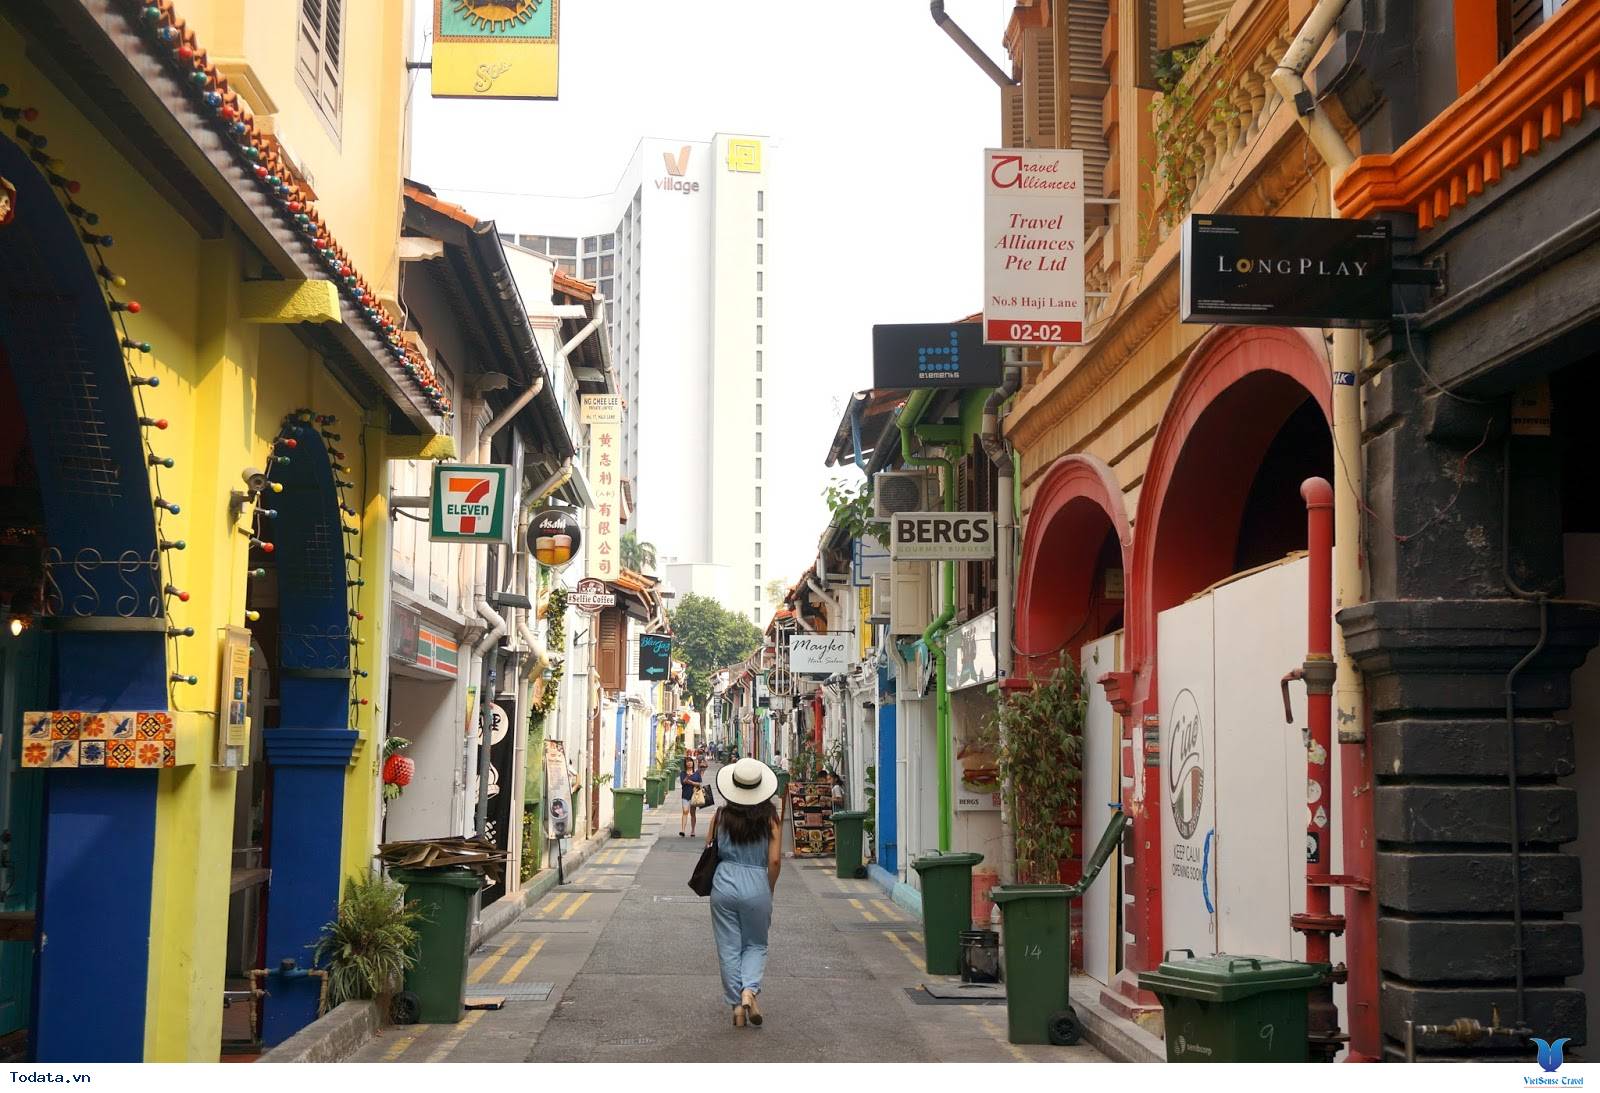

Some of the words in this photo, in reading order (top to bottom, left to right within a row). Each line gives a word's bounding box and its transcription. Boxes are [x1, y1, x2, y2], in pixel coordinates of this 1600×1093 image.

[654, 177, 700, 195] village
[1009, 213, 1064, 230] Travel
[994, 234, 1075, 251] Alliances
[1005, 255, 1032, 271] Pte
[1038, 256, 1067, 271] Ltd
[992, 295, 1018, 306] No.8
[1021, 296, 1046, 309] Haji
[1049, 297, 1078, 308] Lane
[1009, 323, 1062, 341] 02-02
[593, 397, 607, 405] CHEE
[608, 397, 618, 405] LEE
[539, 517, 567, 529] Asahi
[897, 519, 990, 543] BERGS
[592, 595, 614, 604] Coffee
[791, 638, 845, 659] Mayko
[1173, 844, 1185, 860] KEEP
[1185, 846, 1200, 862] CALM
[1172, 863, 1189, 879] OPENING
[1024, 944, 1042, 960] 14
[1259, 1023, 1275, 1050] 9
